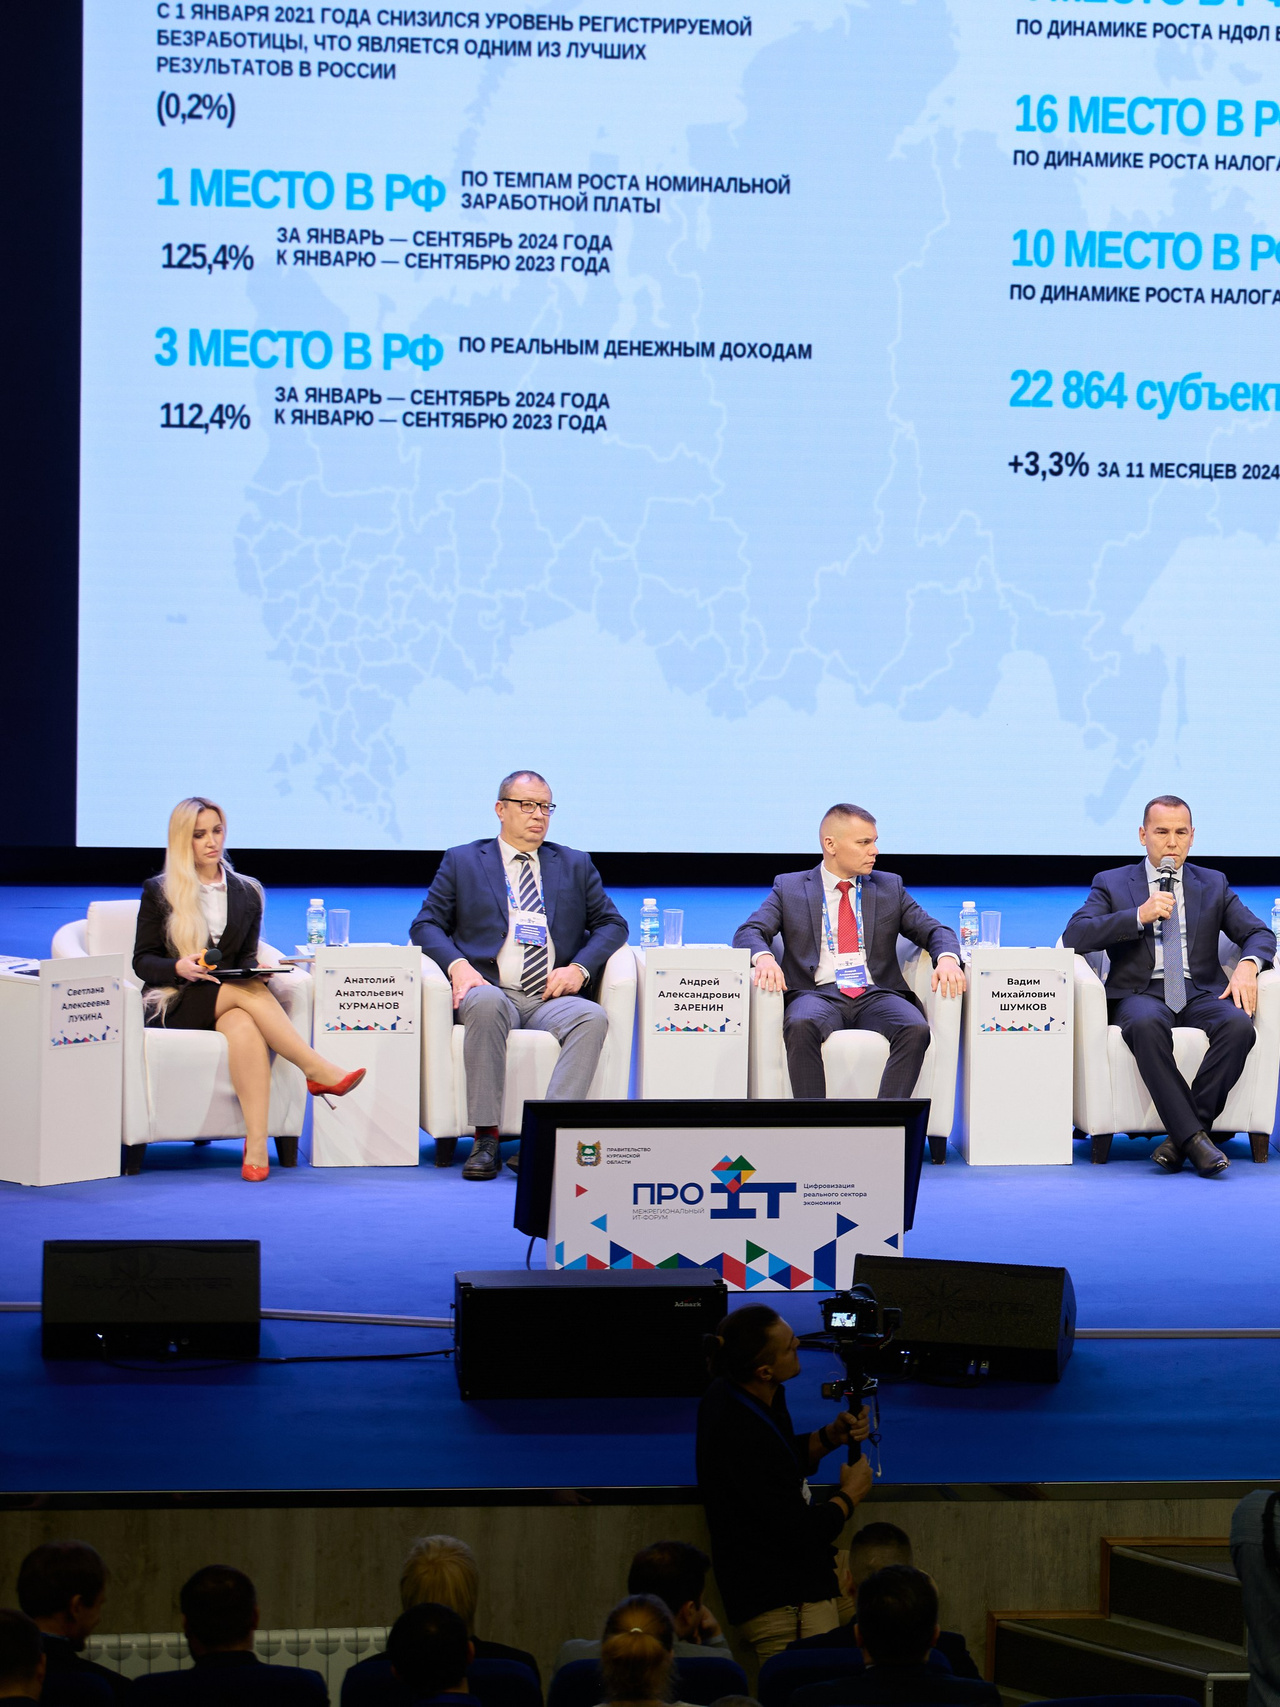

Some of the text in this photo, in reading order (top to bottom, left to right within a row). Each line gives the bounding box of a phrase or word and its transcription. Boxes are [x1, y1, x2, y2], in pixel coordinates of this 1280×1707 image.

[157, 3, 751, 36] С 1 ЯНВАРЯ 2021 ГОДА СНИЗИЛСЯ УРОВЕНЬ РЕГИСТРИРУЕМОЙ
[1017, 19, 1042, 35] ПО
[1047, 20, 1147, 39] ДИНАМИКЕ
[1153, 23, 1212, 39] РОСТА
[1219, 25, 1269, 43] НДФЛ
[157, 29, 646, 60] БЕЗРАБОТИЦЫ, ЧТО ЯВЛЯЕТСЯ ОДНИМ ИЗ ЛУЧШИХ
[157, 57, 395, 79] РЕЗУЛЬТАТОВ В РОССИИ
[157, 91, 235, 128] (0,2%)
[1016, 94, 1058, 133] 16
[1069, 96, 1206, 136] МЕСТО
[1217, 99, 1244, 136] В
[1014, 150, 1039, 166] ПО
[1044, 151, 1143, 169] ДИНАМИКЕ
[1150, 153, 1209, 169] РОСТА
[157, 167, 446, 212] 1 МЕСТО В РФ
[462, 171, 790, 194] ПО ТЕМПАМ РОСТА НОМИНАЛЬНОЙ
[462, 192, 660, 213] ЗАРАБОТНОЙ ПЛАТЫ
[277, 227, 612, 254] ЗА ЯНВАРЬ СЕНТЯБРЬ 2024 ГОДА
[1012, 229, 1055, 268] 10
[1065, 230, 1203, 271] МЕСТО
[1213, 233, 1240, 270] В
[162, 243, 254, 274] 125,4%
[277, 250, 610, 276] К ЯНВАРЮ СЕНТЯБРЮ 2023 ГОДА
[1010, 284, 1035, 300] ПО
[1041, 285, 1140, 304] ДИНАМИКЕ
[1146, 287, 1205, 303] РОСТА
[155, 327, 444, 371] 3 МЕСТО В РФ
[459, 337, 812, 362] ПО РЕАЛЬНЫМ ДЕНЕЖНЫМ ДОХОДАМ
[275, 387, 609, 412] ЗА ЯНВАРЬ СЕНТЯБРЬ 2024 ГОДА
[1010, 369, 1053, 407] 22
[1062, 370, 1128, 409] 864
[161, 403, 250, 434] 112,4%
[1009, 451, 1089, 481] +3,3%
[1098, 462, 1120, 477] ЗА
[1127, 463, 1144, 478] 11
[1150, 463, 1236, 481] МЕСЯЦЕВ
[1242, 464, 1280, 479] 2024
[66, 986, 105, 997] Светлана
[343, 976, 396, 984] Анатолий
[679, 977, 720, 988] Андрей
[1007, 977, 1041, 987] Вадим
[334, 989, 404, 997] Анатольевич
[657, 990, 741, 1001] Александрович
[991, 990, 1056, 999] Михайлович
[61, 999, 110, 1011] Алексеевна
[339, 1001, 400, 1010] КУРМАНОВ
[673, 1003, 724, 1012] ЗАРЕНИН
[999, 1003, 1047, 1011] ШУМКОВ
[68, 1012, 103, 1023] ЛУКИНА
[633, 1182, 704, 1205] ПРО
